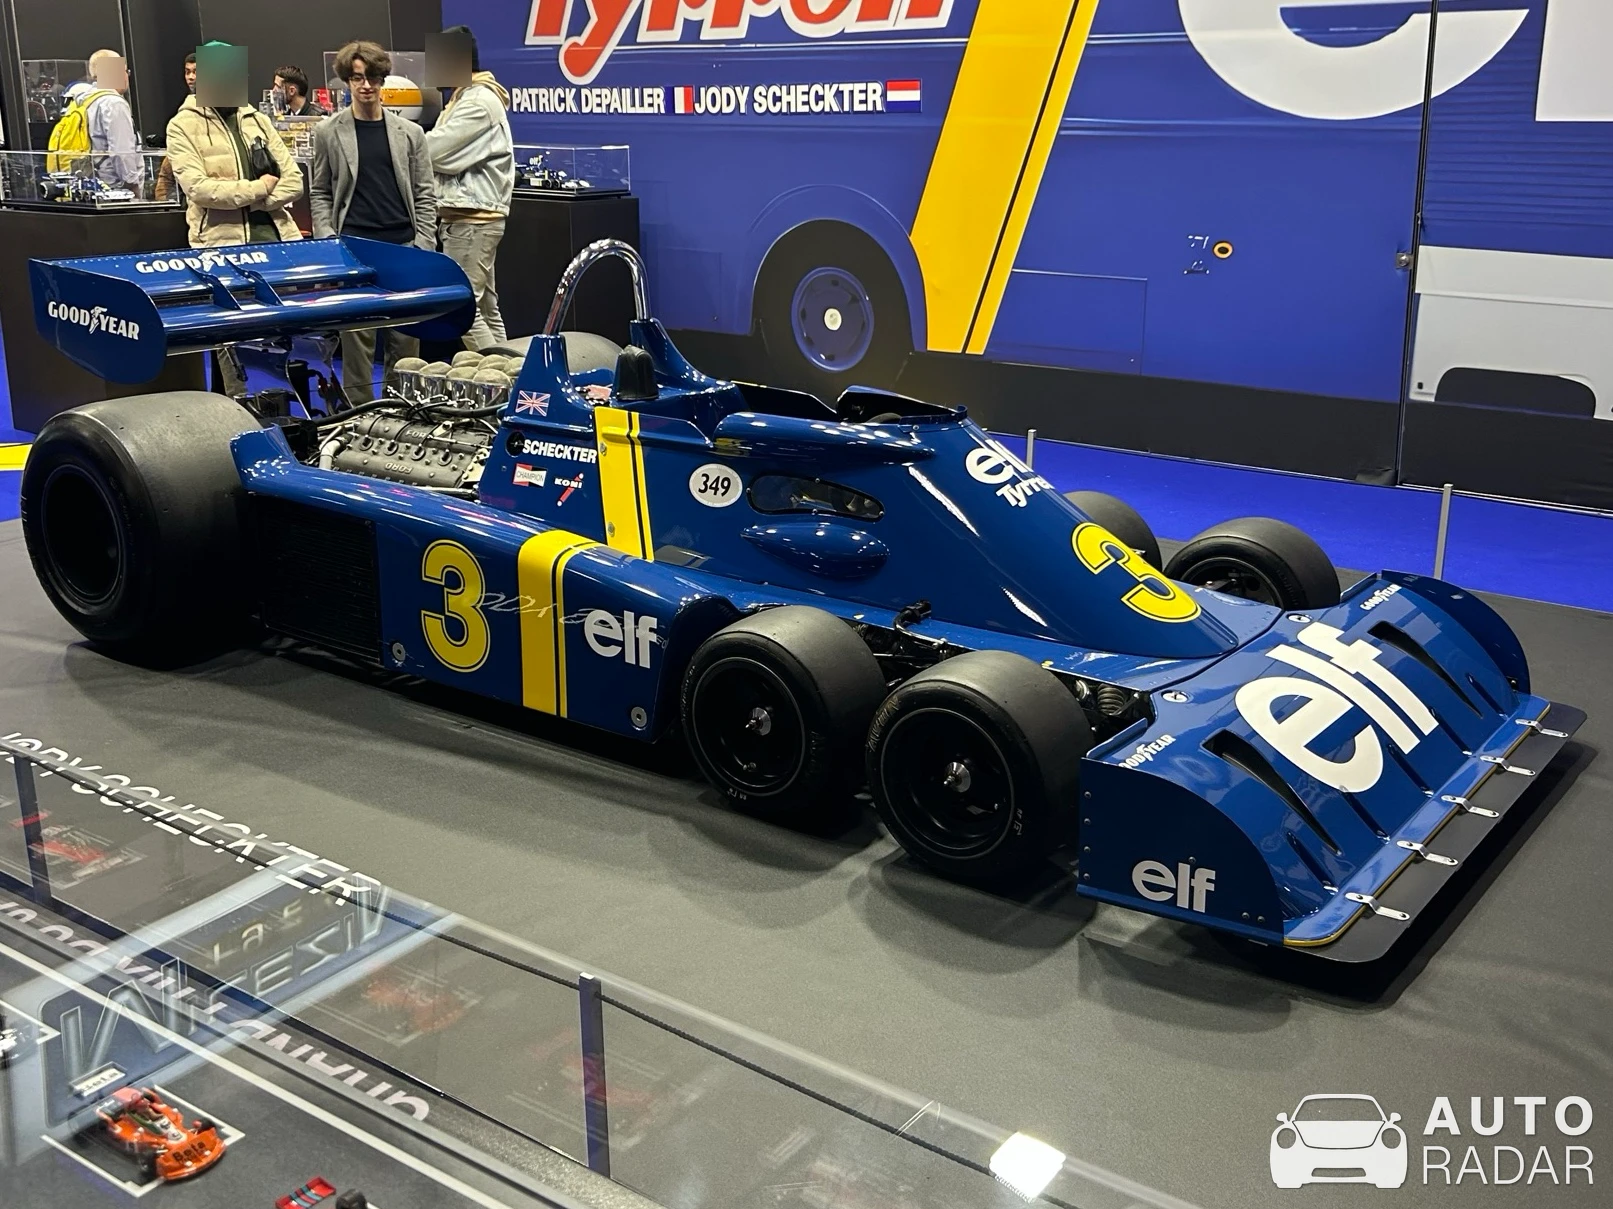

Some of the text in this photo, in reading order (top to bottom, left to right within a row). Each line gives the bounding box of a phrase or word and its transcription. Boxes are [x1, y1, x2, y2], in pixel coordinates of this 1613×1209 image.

[511, 87, 666, 114] PATRICK DEPAILLER
[694, 82, 884, 114] JODY SCHECKTER
[48, 301, 140, 340] GOODYEAR
[522, 439, 598, 464] SCHECKTER
[516, 470, 545, 482] CHAMPION
[554, 477, 583, 489] KONI
[698, 473, 732, 497] 349
[1071, 522, 1202, 623] 3
[421, 539, 491, 673] 3
[584, 608, 658, 669] elf
[1234, 621, 1440, 793] elf
[1131, 859, 1216, 914] elf
